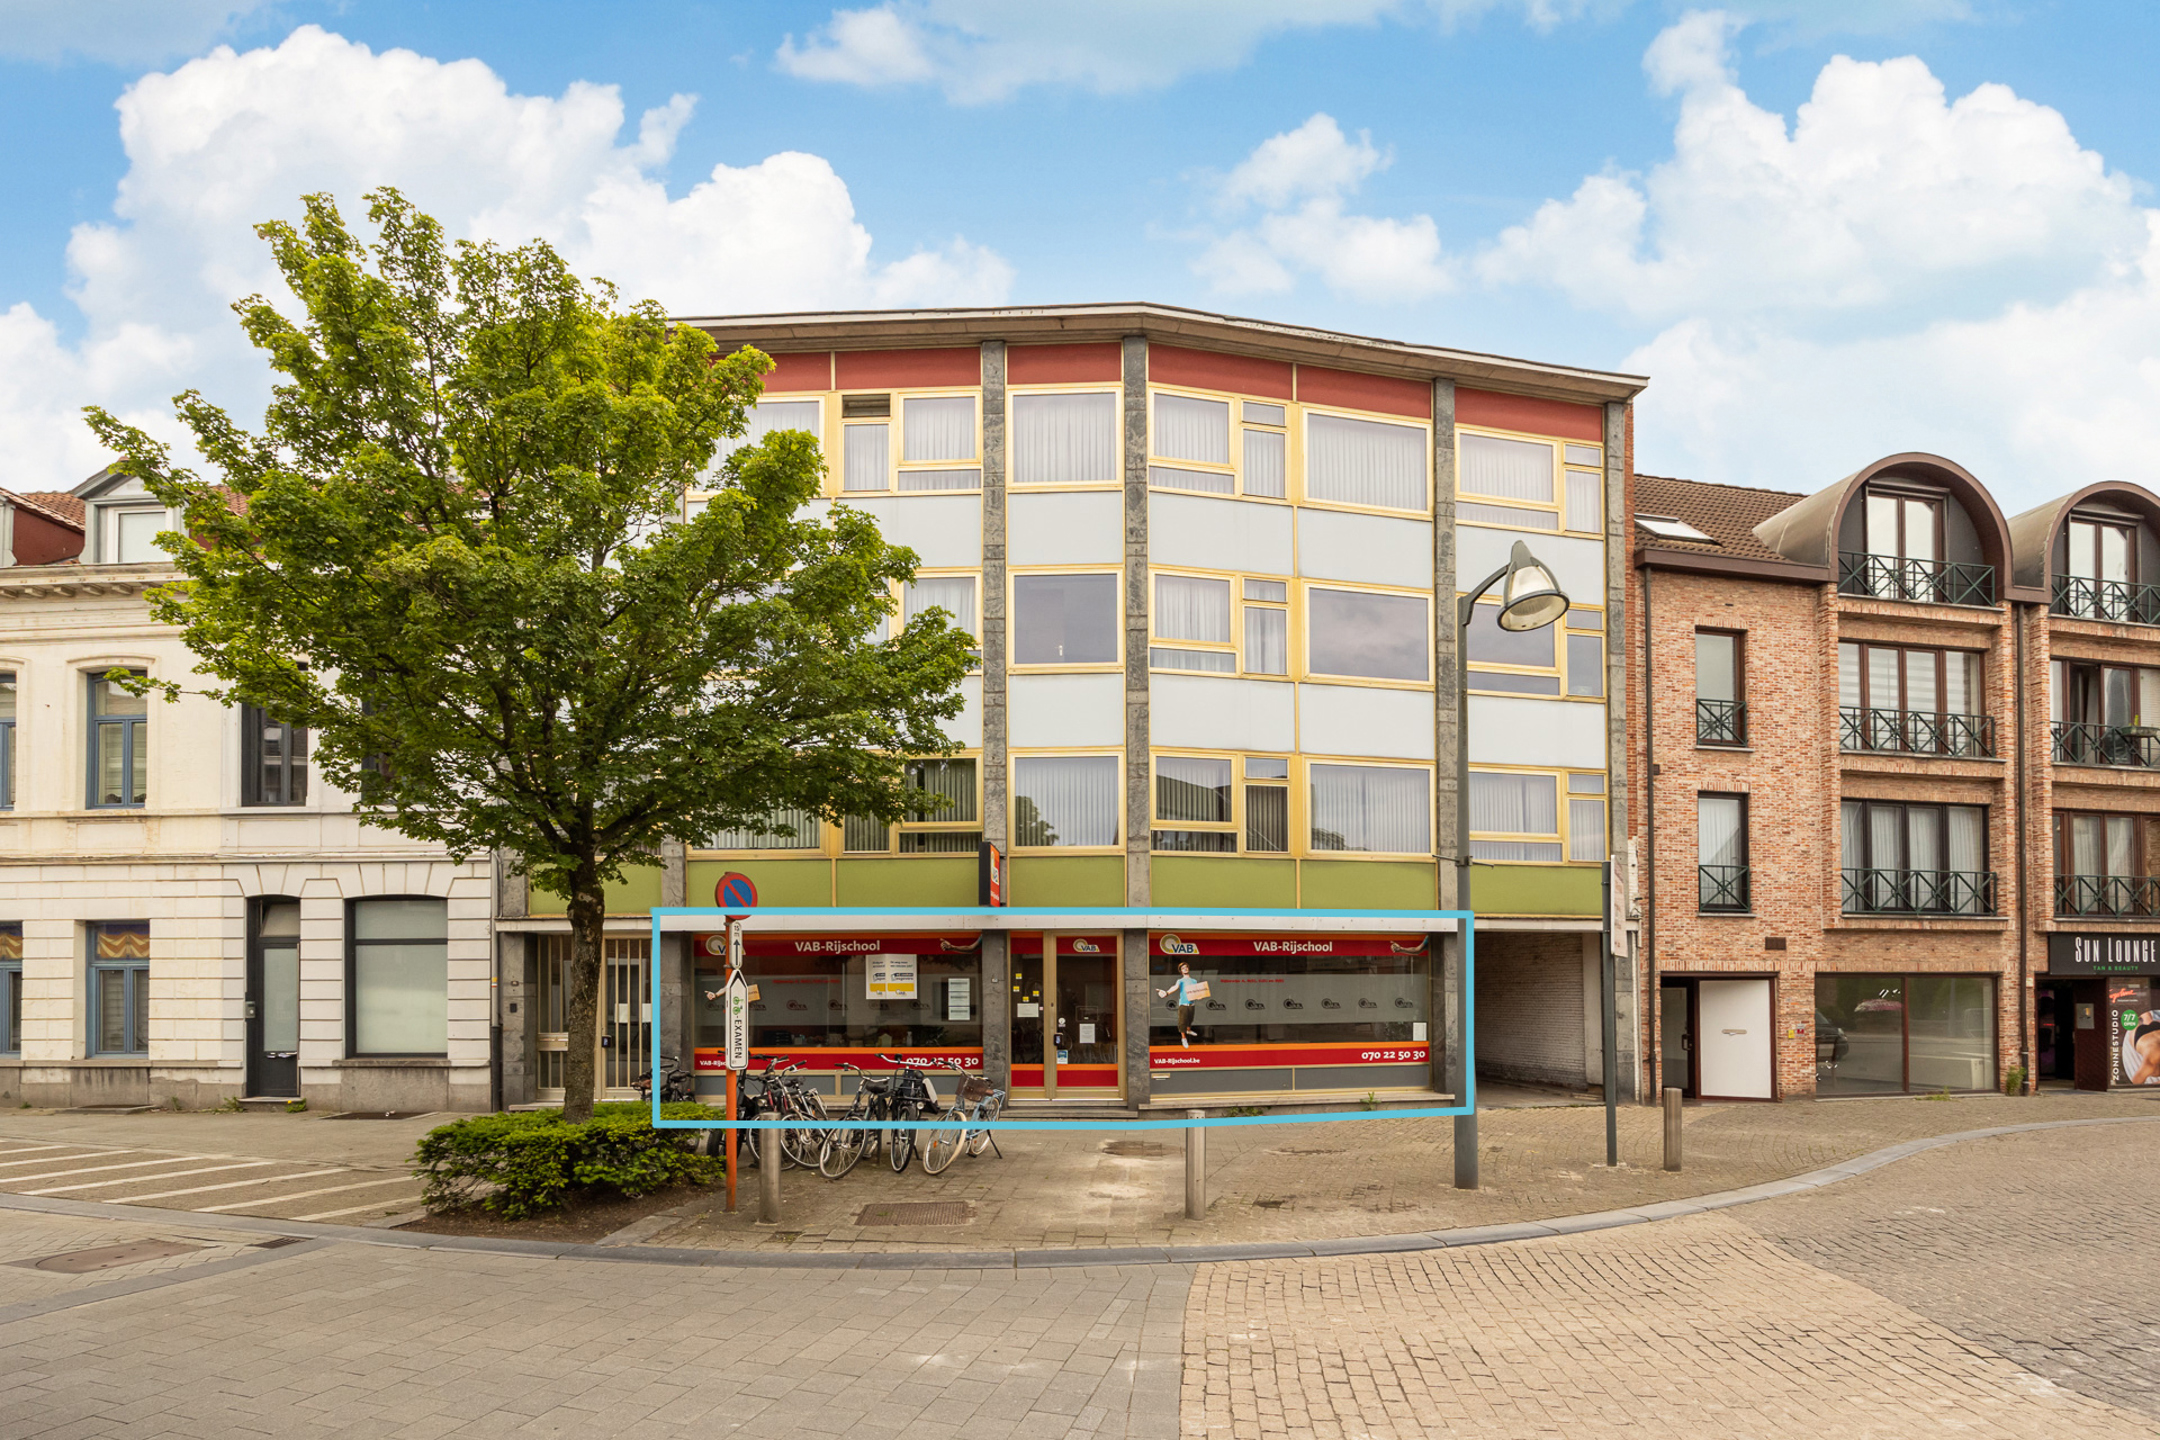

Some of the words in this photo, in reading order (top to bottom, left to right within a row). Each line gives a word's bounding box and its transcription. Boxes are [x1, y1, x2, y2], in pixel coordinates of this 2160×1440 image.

[794, 940, 881, 955] VAB-Rijschool
[1171, 943, 1195, 954] VAB
[1253, 941, 1333, 954] VAB-Rijschool
[2111, 1009, 2120, 1081] ZONNESTUDIO
[1361, 1051, 1381, 1061] 070
[1383, 1051, 1396, 1059] 22
[1398, 1051, 1411, 1061] 50
[1413, 1050, 1426, 1061] 30
[964, 1057, 980, 1067] 30
